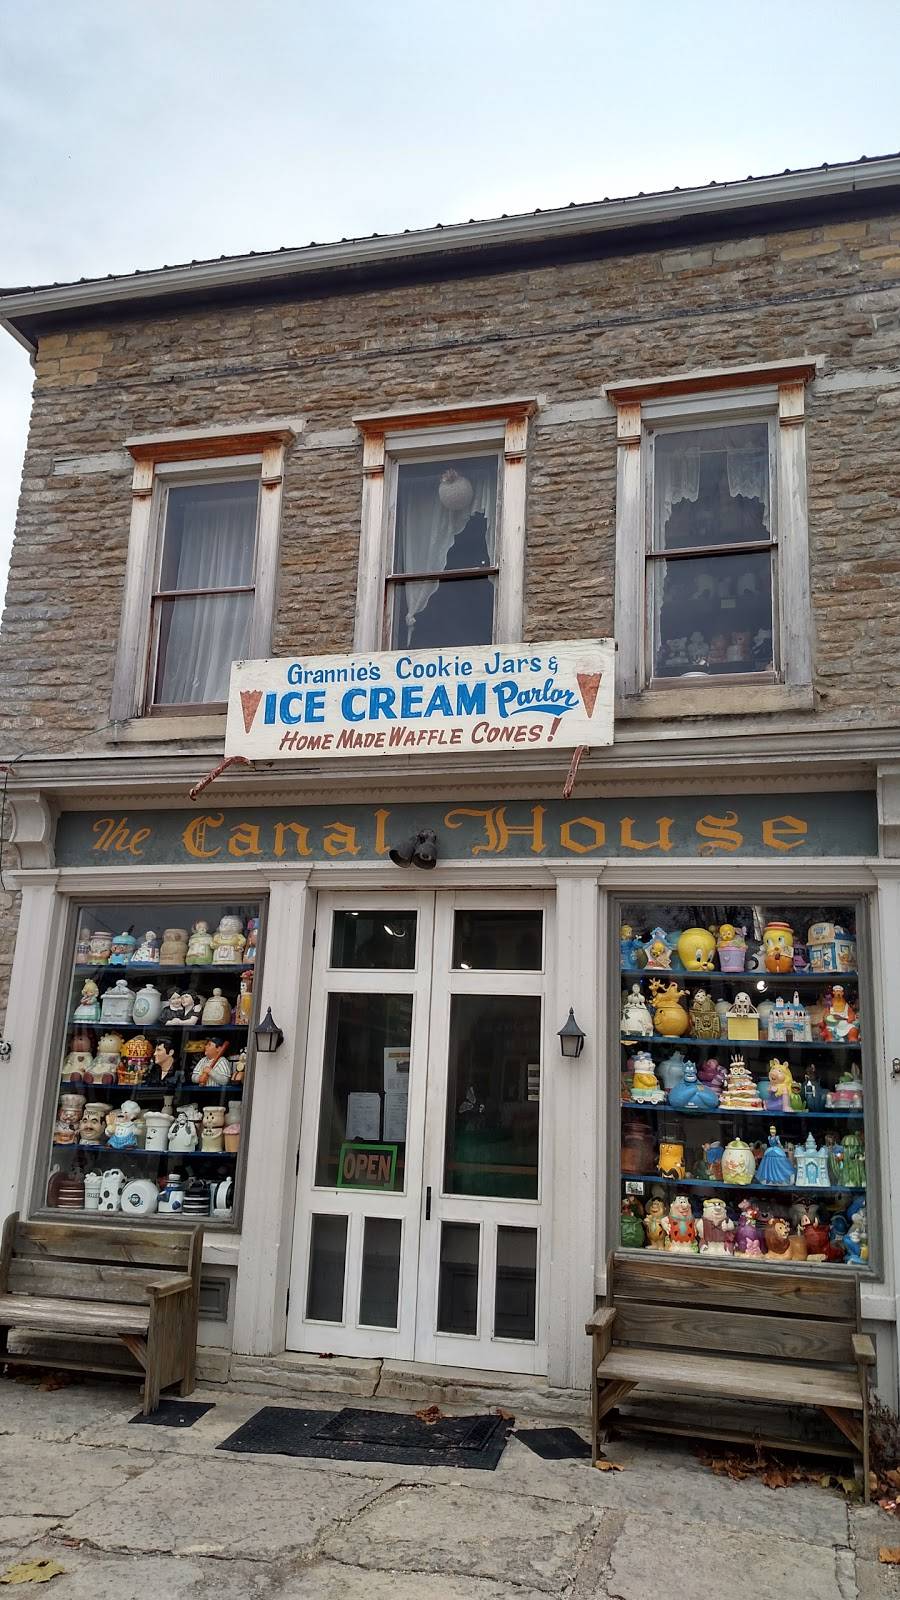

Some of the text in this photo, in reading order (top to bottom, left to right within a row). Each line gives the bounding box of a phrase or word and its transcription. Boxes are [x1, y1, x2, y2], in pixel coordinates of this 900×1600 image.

[287, 652, 559, 685] Grannie's Cookie Jars &
[264, 678, 580, 725] ICE CREAM Parlor
[279, 731, 333, 750] HOME
[338, 728, 386, 748] MADE
[387, 726, 463, 747] WAFFLE
[92, 804, 809, 858] The Canal House
[344, 1154, 391, 1181] OPEN
